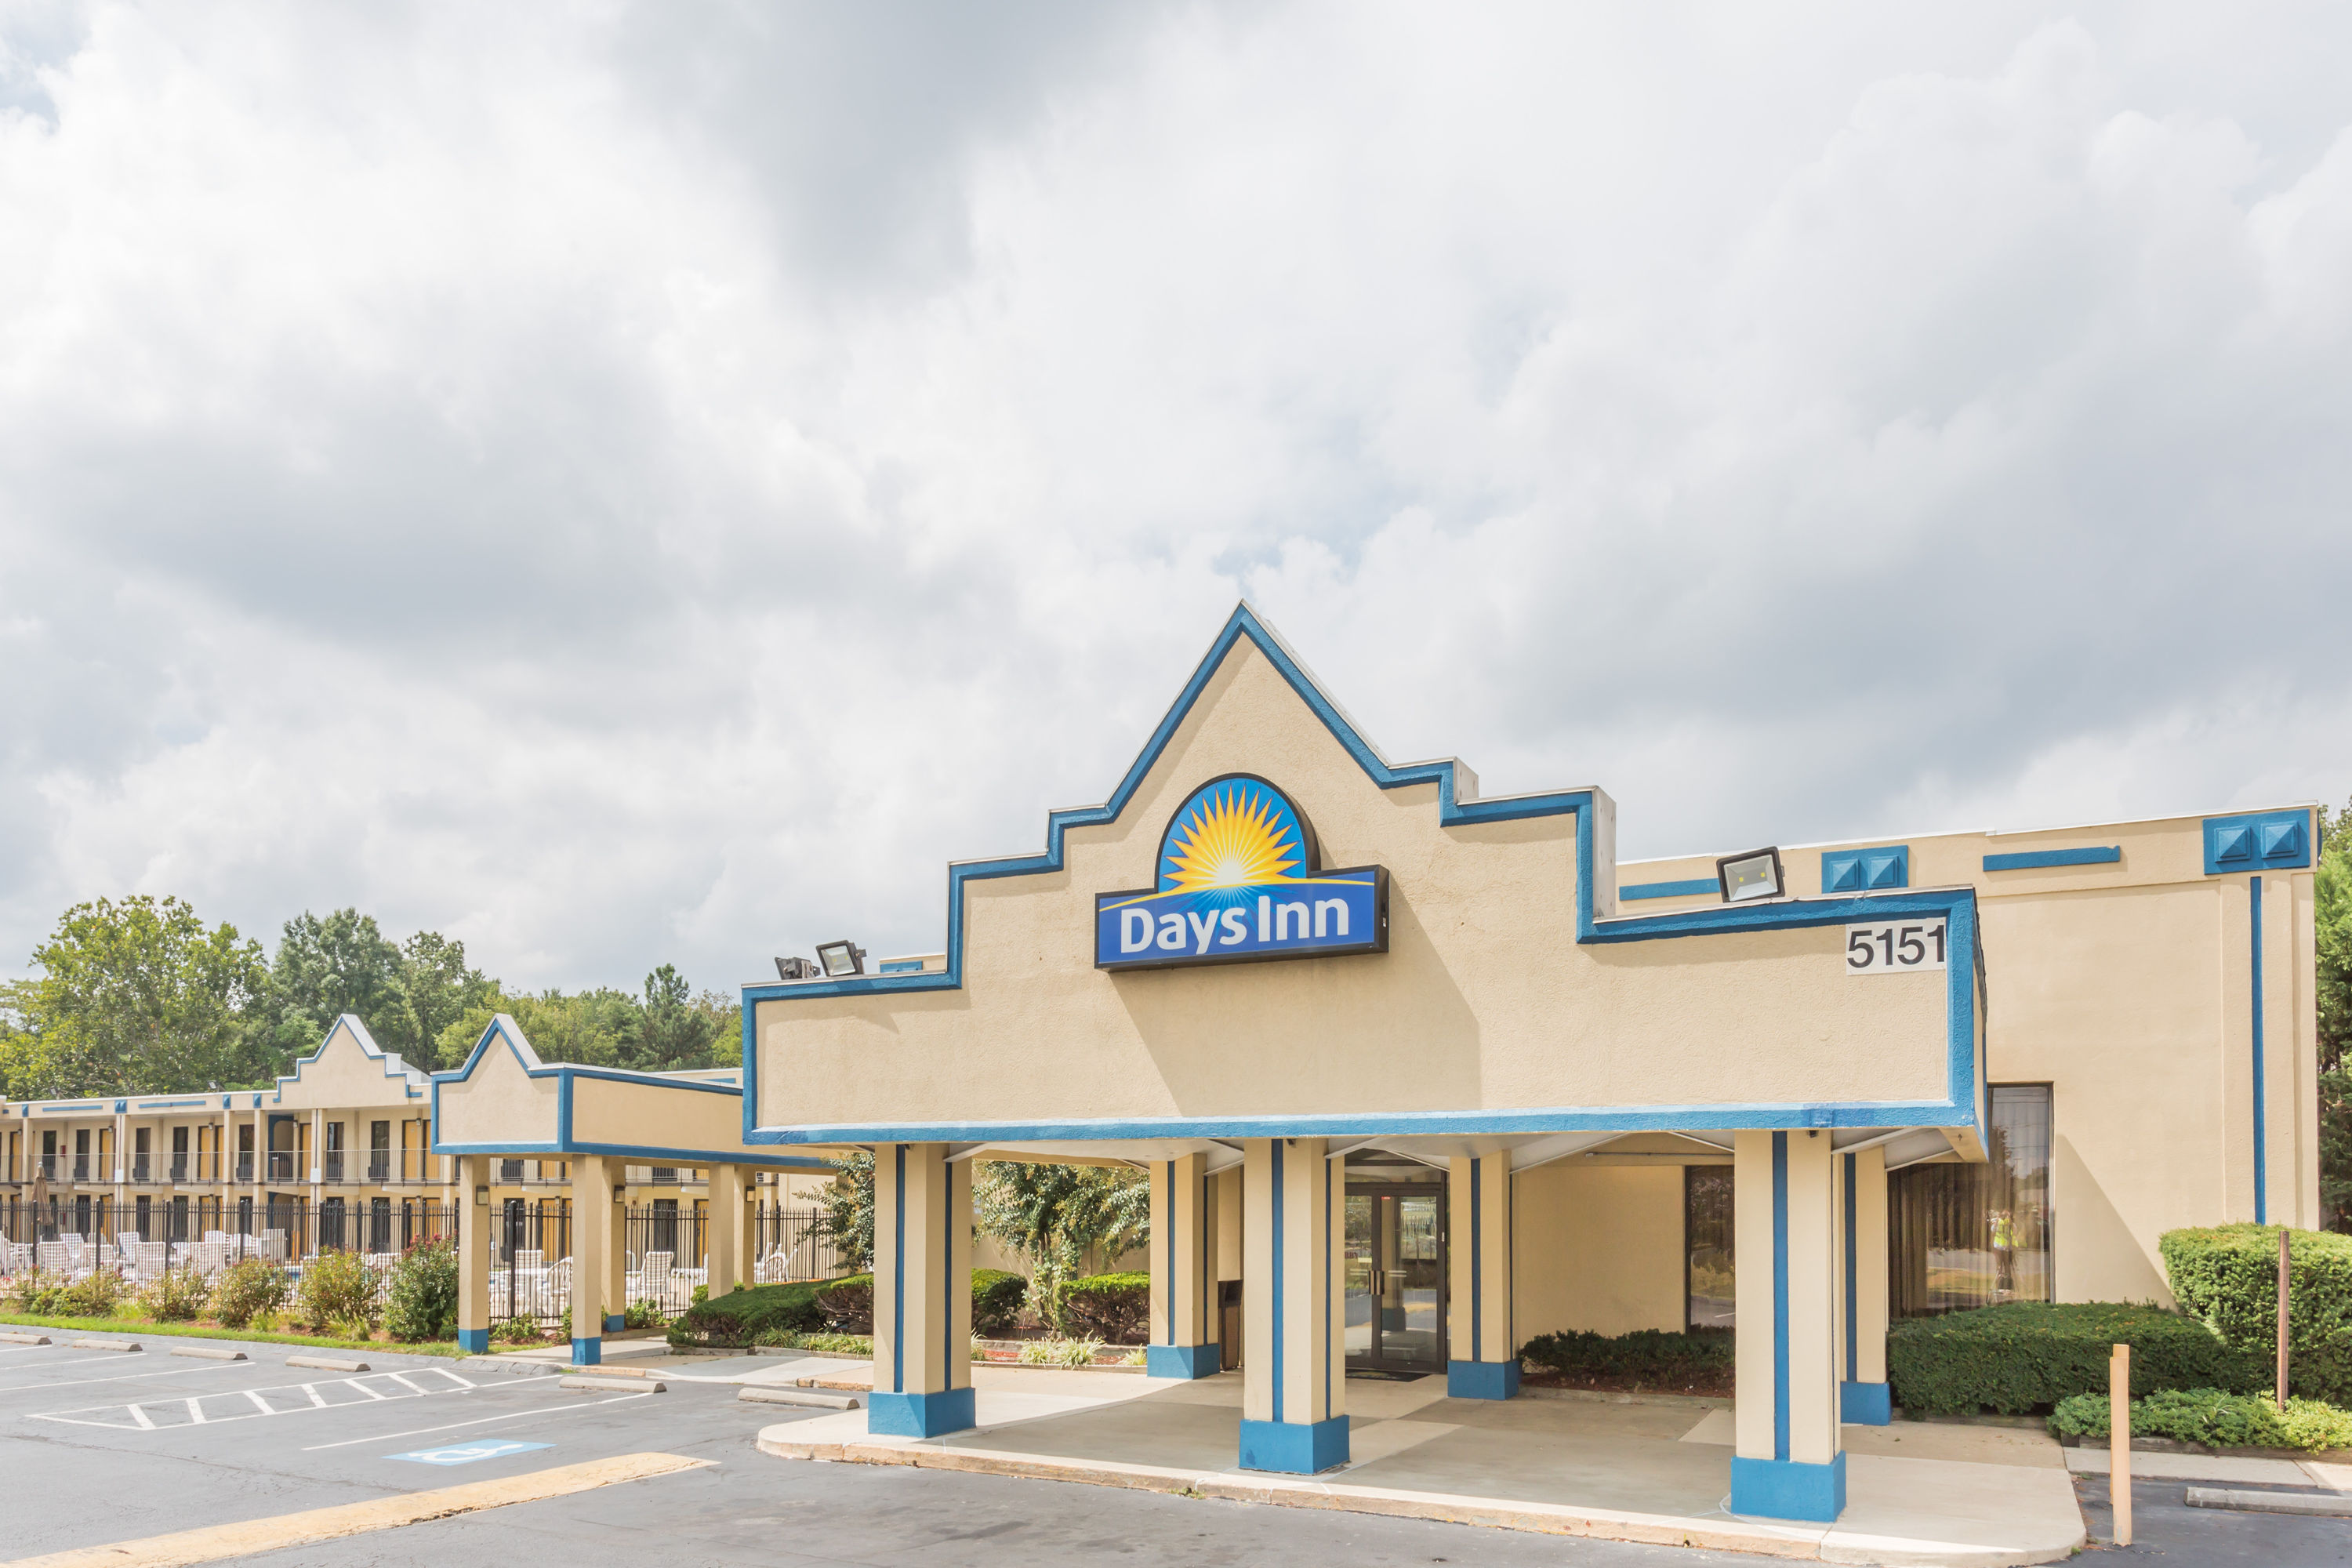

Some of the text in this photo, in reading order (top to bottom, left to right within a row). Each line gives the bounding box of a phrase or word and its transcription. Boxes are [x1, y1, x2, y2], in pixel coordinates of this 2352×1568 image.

[1120, 895, 1349, 955] Days Inn
[1847, 924, 1945, 968] 5151
